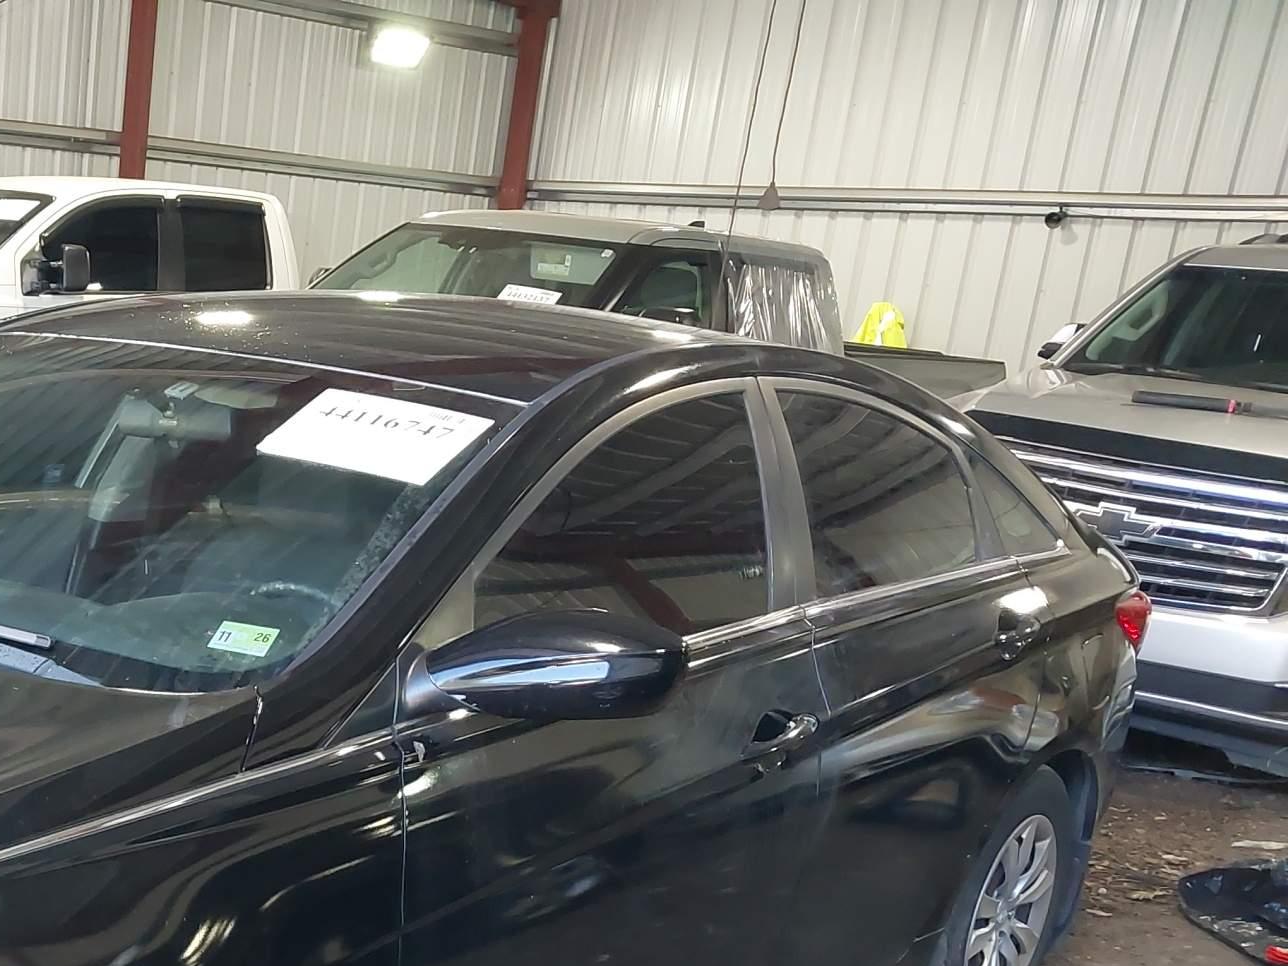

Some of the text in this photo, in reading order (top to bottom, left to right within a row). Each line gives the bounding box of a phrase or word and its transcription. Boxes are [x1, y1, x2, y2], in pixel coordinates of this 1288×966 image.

[319, 405, 455, 439] 44116747
[217, 630, 272, 643] 11 26
